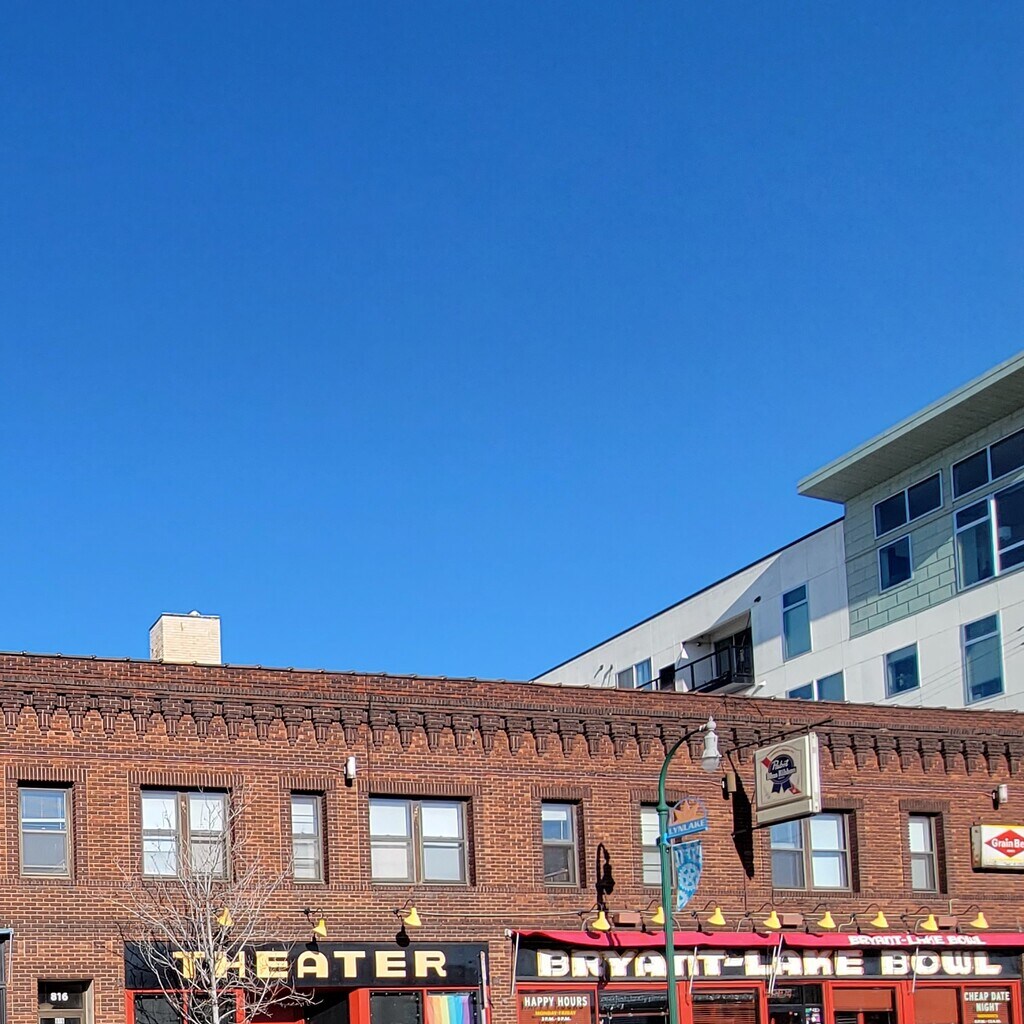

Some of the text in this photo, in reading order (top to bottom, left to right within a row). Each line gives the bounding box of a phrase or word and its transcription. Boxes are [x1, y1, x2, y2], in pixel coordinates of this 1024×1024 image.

[669, 820, 705, 834] LYNLAKE
[991, 838, 1014, 848] Grain
[848, 935, 986, 945] BRYANT-LAKE BOWL
[172, 950, 447, 978] THEATER
[537, 949, 1003, 977] BRYANT-LAKE BOWL
[50, 992, 69, 1001] 816
[964, 991, 1010, 1001] CHEAP DATE
[524, 996, 554, 1007] HAPPY
[558, 996, 587, 1007] HOURS
[976, 1002, 1001, 1012] NIGHT
